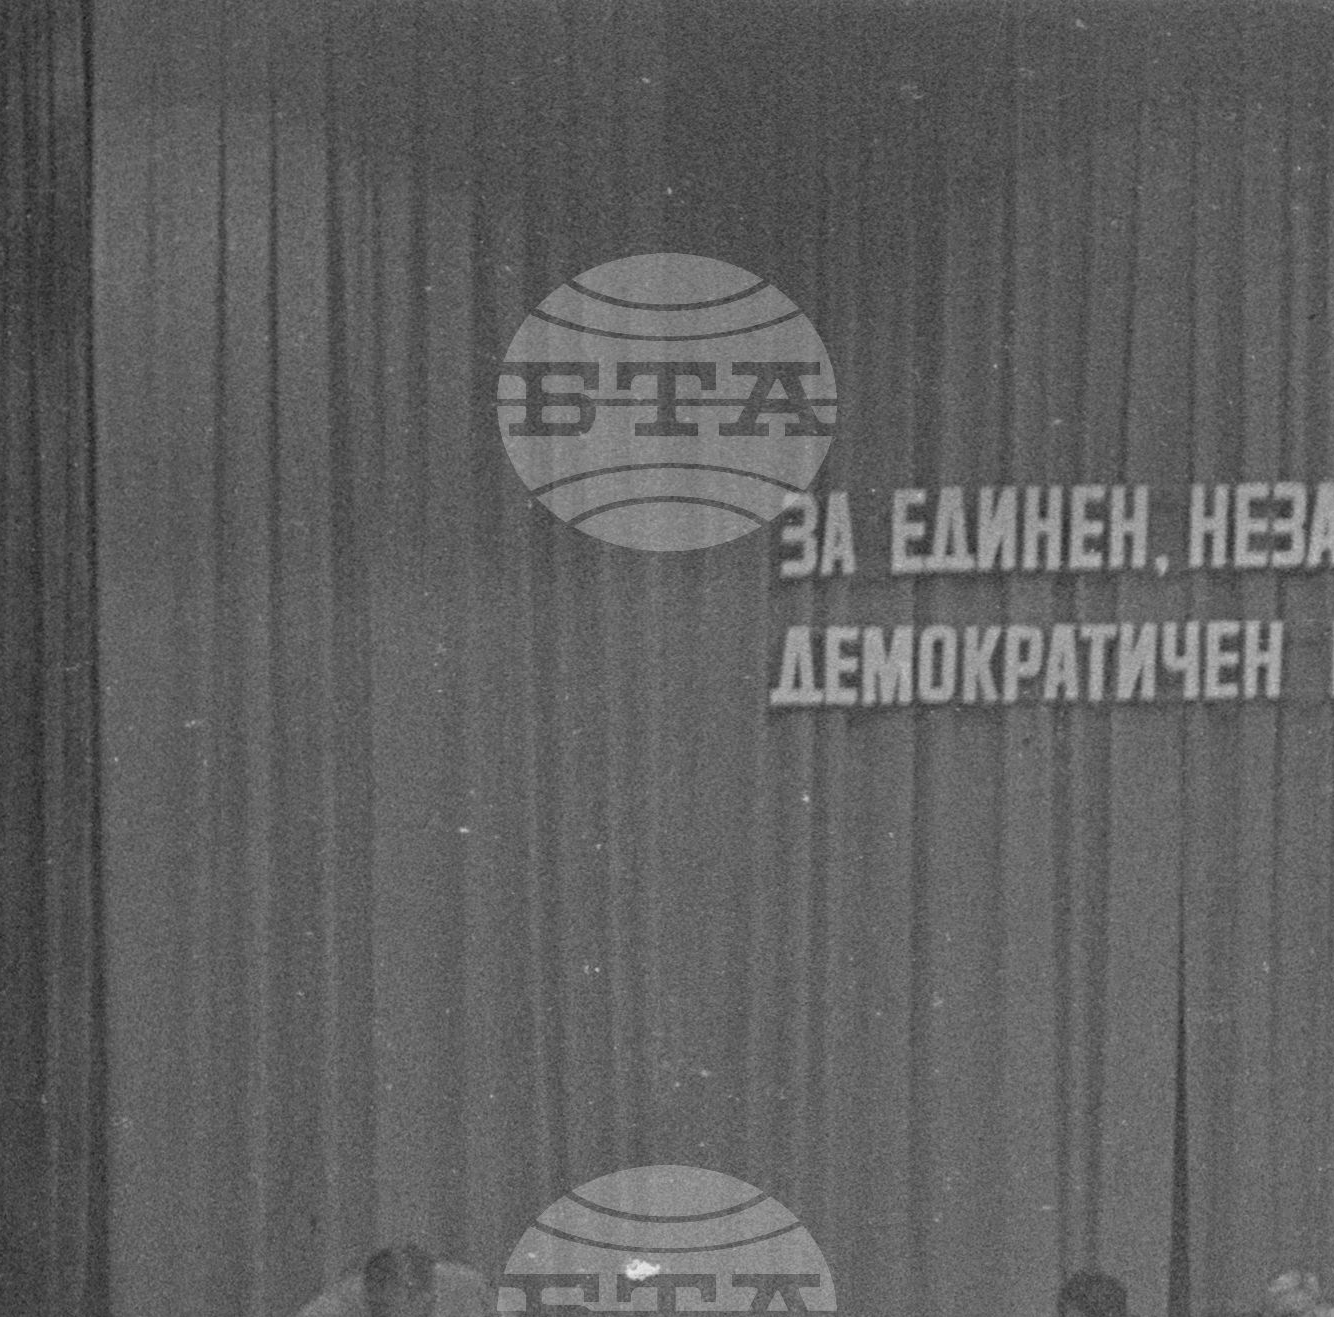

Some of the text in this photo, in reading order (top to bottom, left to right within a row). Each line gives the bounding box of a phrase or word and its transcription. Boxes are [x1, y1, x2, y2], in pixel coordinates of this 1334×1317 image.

[779, 490, 856, 578] ЗА
[891, 483, 1169, 578] ЕДИНЕН,
[769, 619, 1283, 706] ДЕМОКРАТИЧЕН
